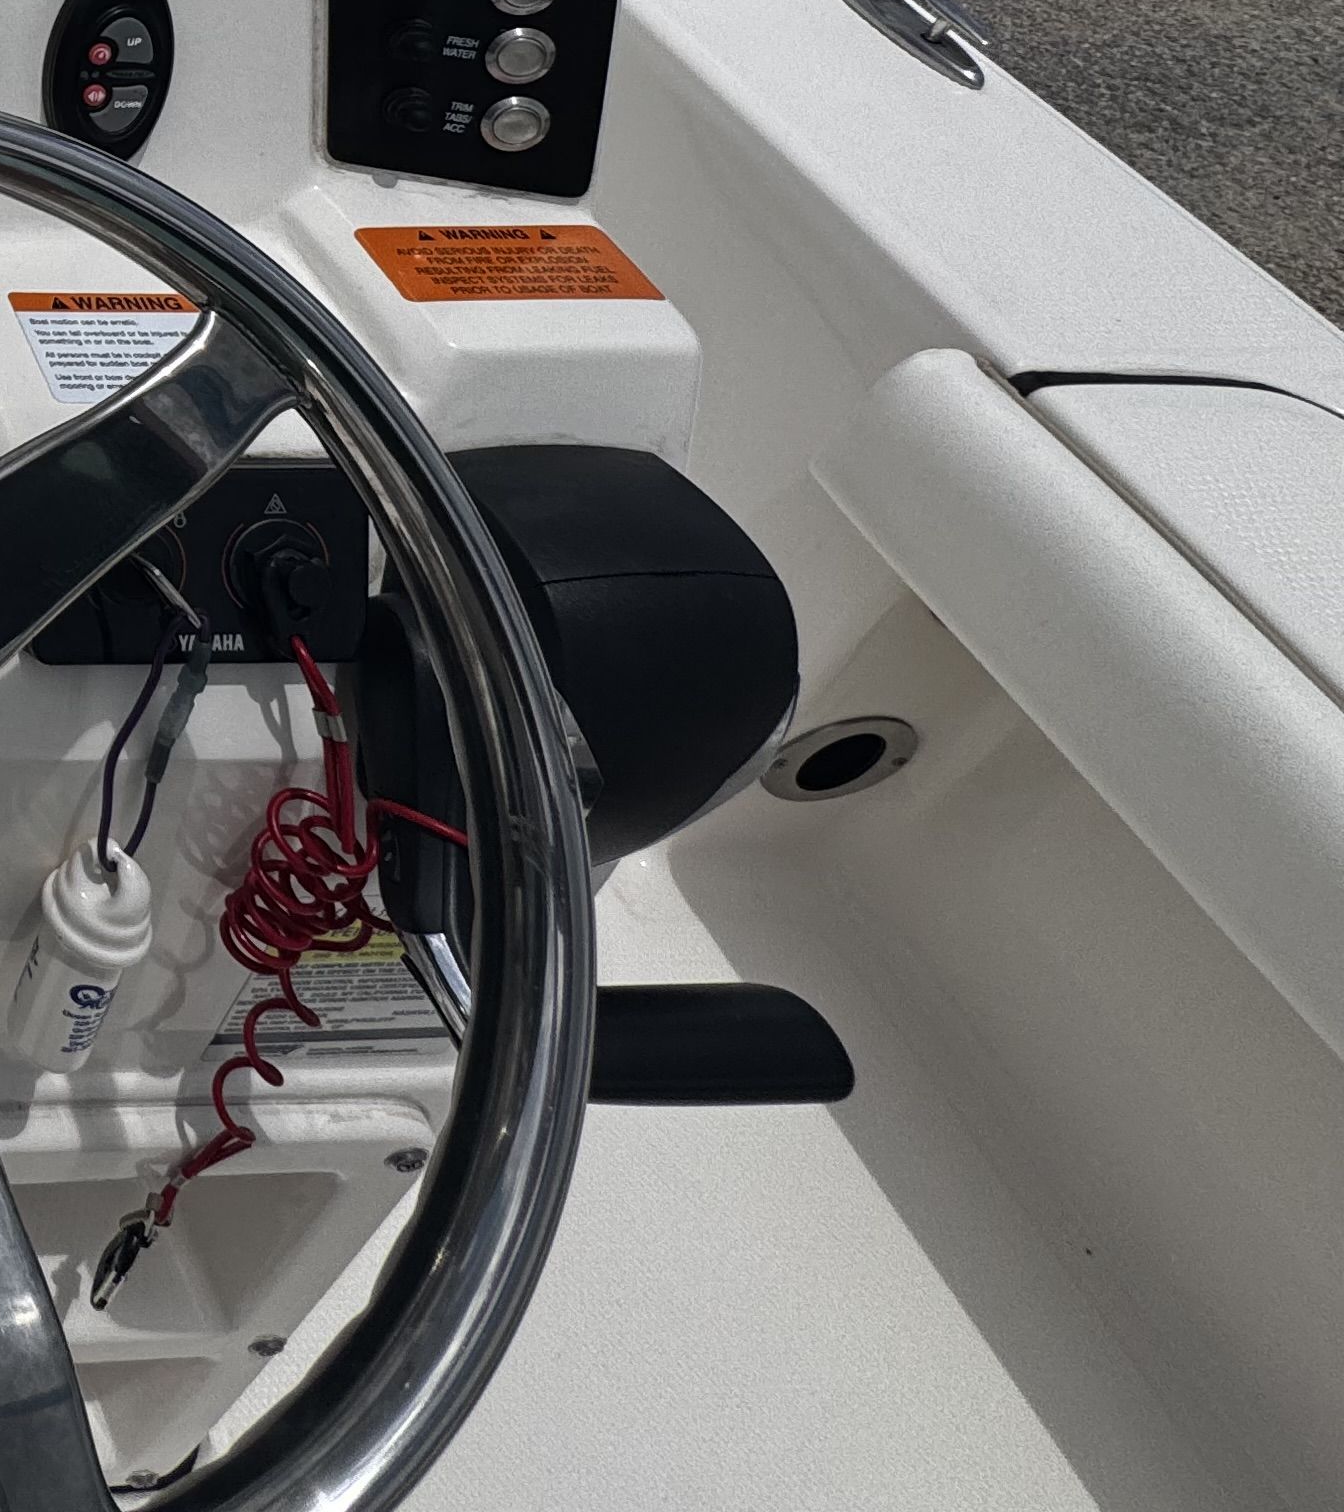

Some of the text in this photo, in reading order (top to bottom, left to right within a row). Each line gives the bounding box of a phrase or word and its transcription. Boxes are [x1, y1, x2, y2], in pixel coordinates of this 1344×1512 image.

[127, 37, 143, 47] UP
[446, 35, 480, 49] FRESH
[442, 47, 477, 60] WATER
[114, 100, 143, 109] DOWN
[450, 101, 474, 113] TRIM
[443, 122, 466, 134] ACC
[438, 229, 530, 240] WARNING
[434, 247, 491, 255] SERIOUS
[426, 256, 465, 265] FROM
[71, 296, 184, 311] WARNING
